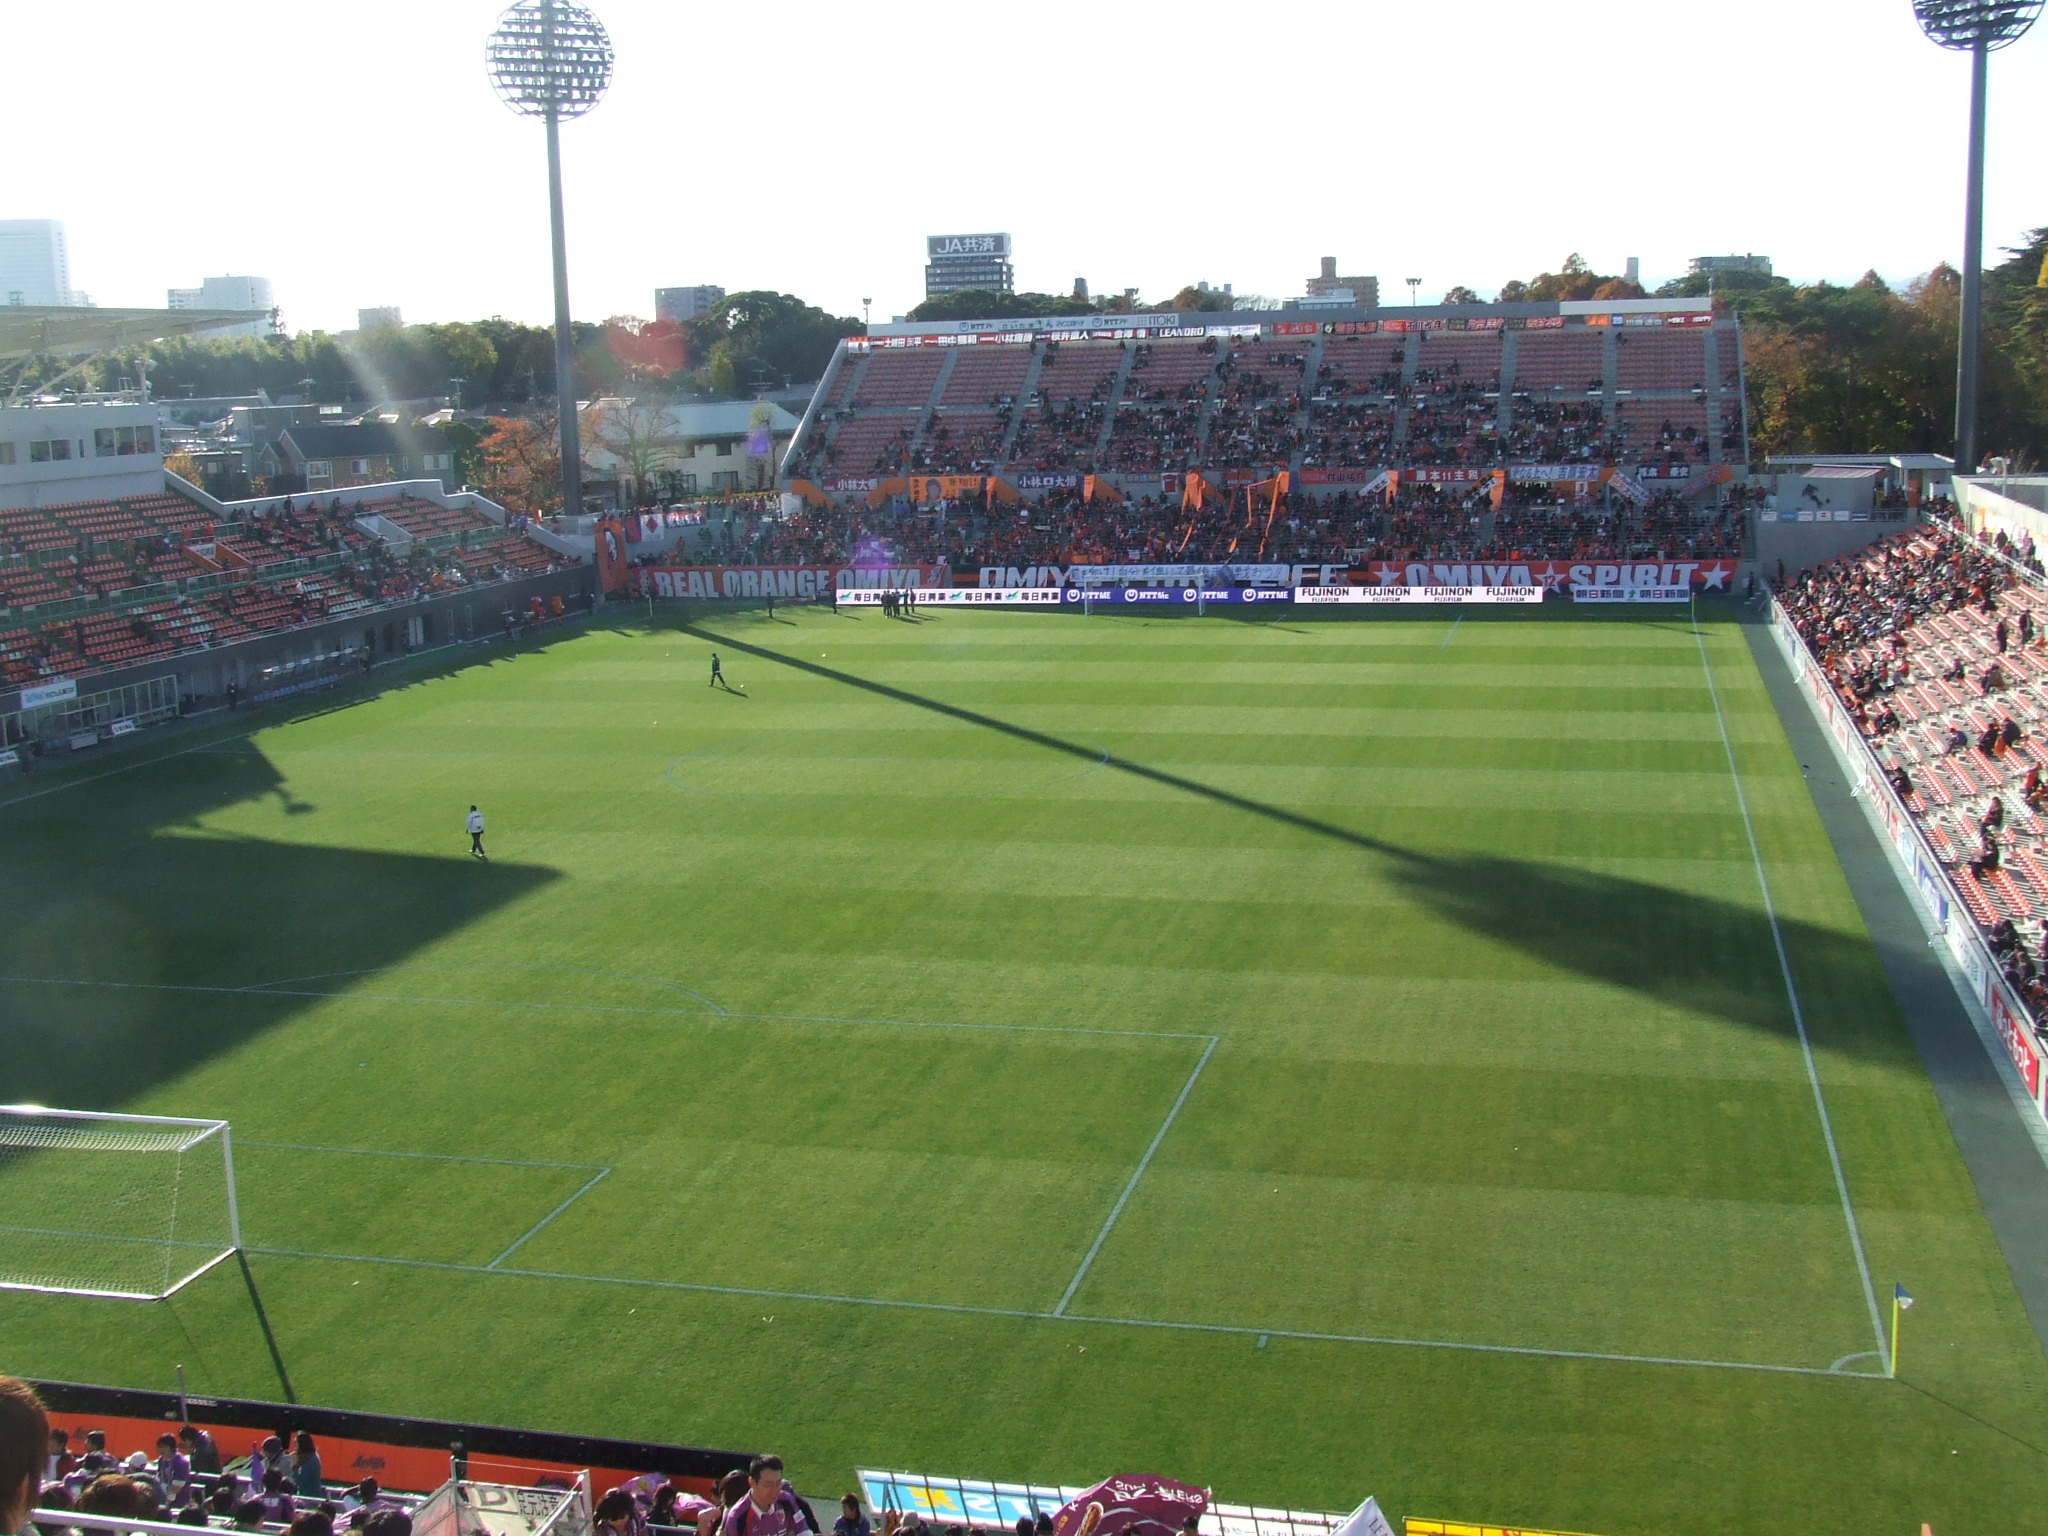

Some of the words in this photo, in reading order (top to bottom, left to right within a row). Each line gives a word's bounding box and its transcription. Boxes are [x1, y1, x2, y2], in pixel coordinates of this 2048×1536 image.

[936, 236, 996, 254] JA共済
[1149, 314, 1176, 326] ITOKI
[1160, 327, 1205, 338] LEANDRO
[1405, 564, 1534, 589] OMIYA
[1568, 563, 1699, 589] SPIRIT
[654, 570, 720, 598] REAL
[722, 569, 830, 598] ORANGE
[836, 567, 922, 590] OMIYA
[854, 591, 883, 602] 毎日興
[913, 591, 946, 602] 日興業
[965, 591, 1003, 602] 毎日興業
[1021, 591, 1060, 601] 毎日興業
[1302, 587, 1349, 597] FUJINON
[1363, 587, 1410, 597] FUJINON
[1425, 587, 1472, 597] FUJINON
[1486, 587, 1535, 597] FUJINON
[1575, 589, 1624, 599] 朝日新聞
[1639, 588, 1688, 598] 朝日新聞
